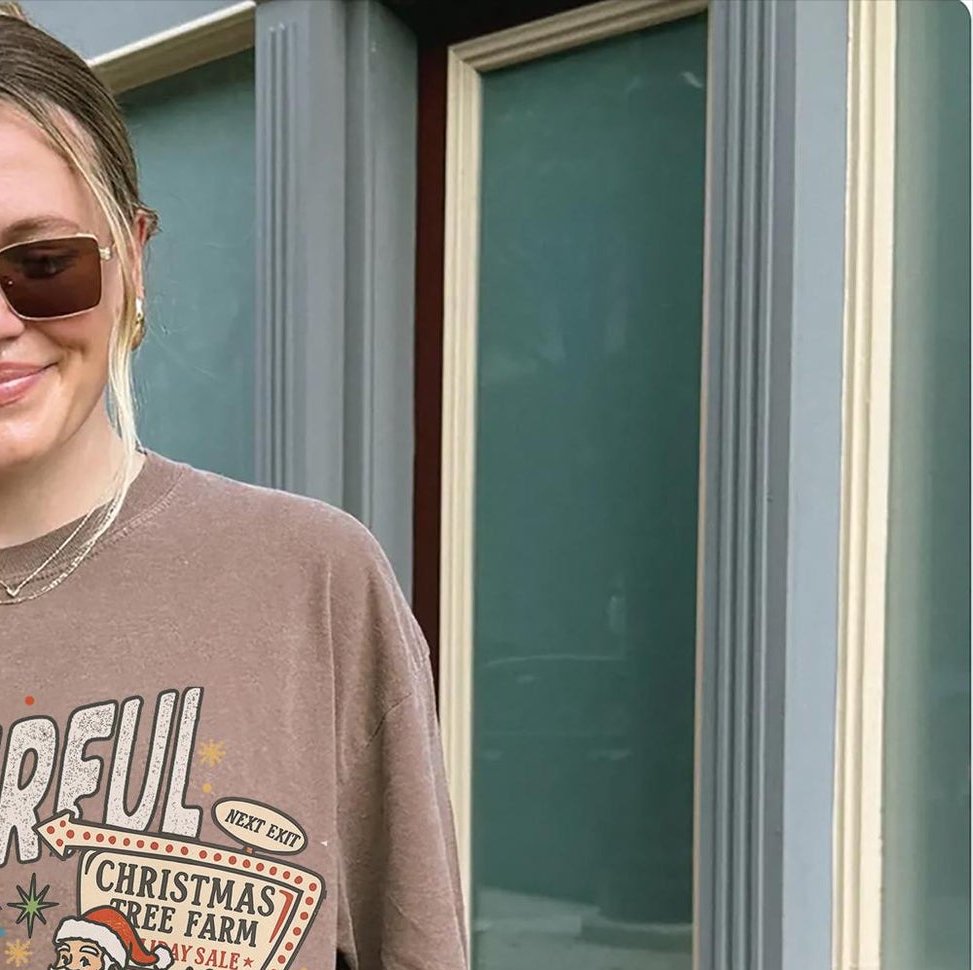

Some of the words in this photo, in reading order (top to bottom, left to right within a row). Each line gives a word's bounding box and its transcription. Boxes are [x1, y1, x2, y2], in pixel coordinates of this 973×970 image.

[225, 808, 265, 833] NEXT
[266, 823, 302, 848] EXIT
[96, 859, 276, 917] CHRISTMAS
[184, 911, 258, 947] FARM
[194, 946, 241, 970] SALE
